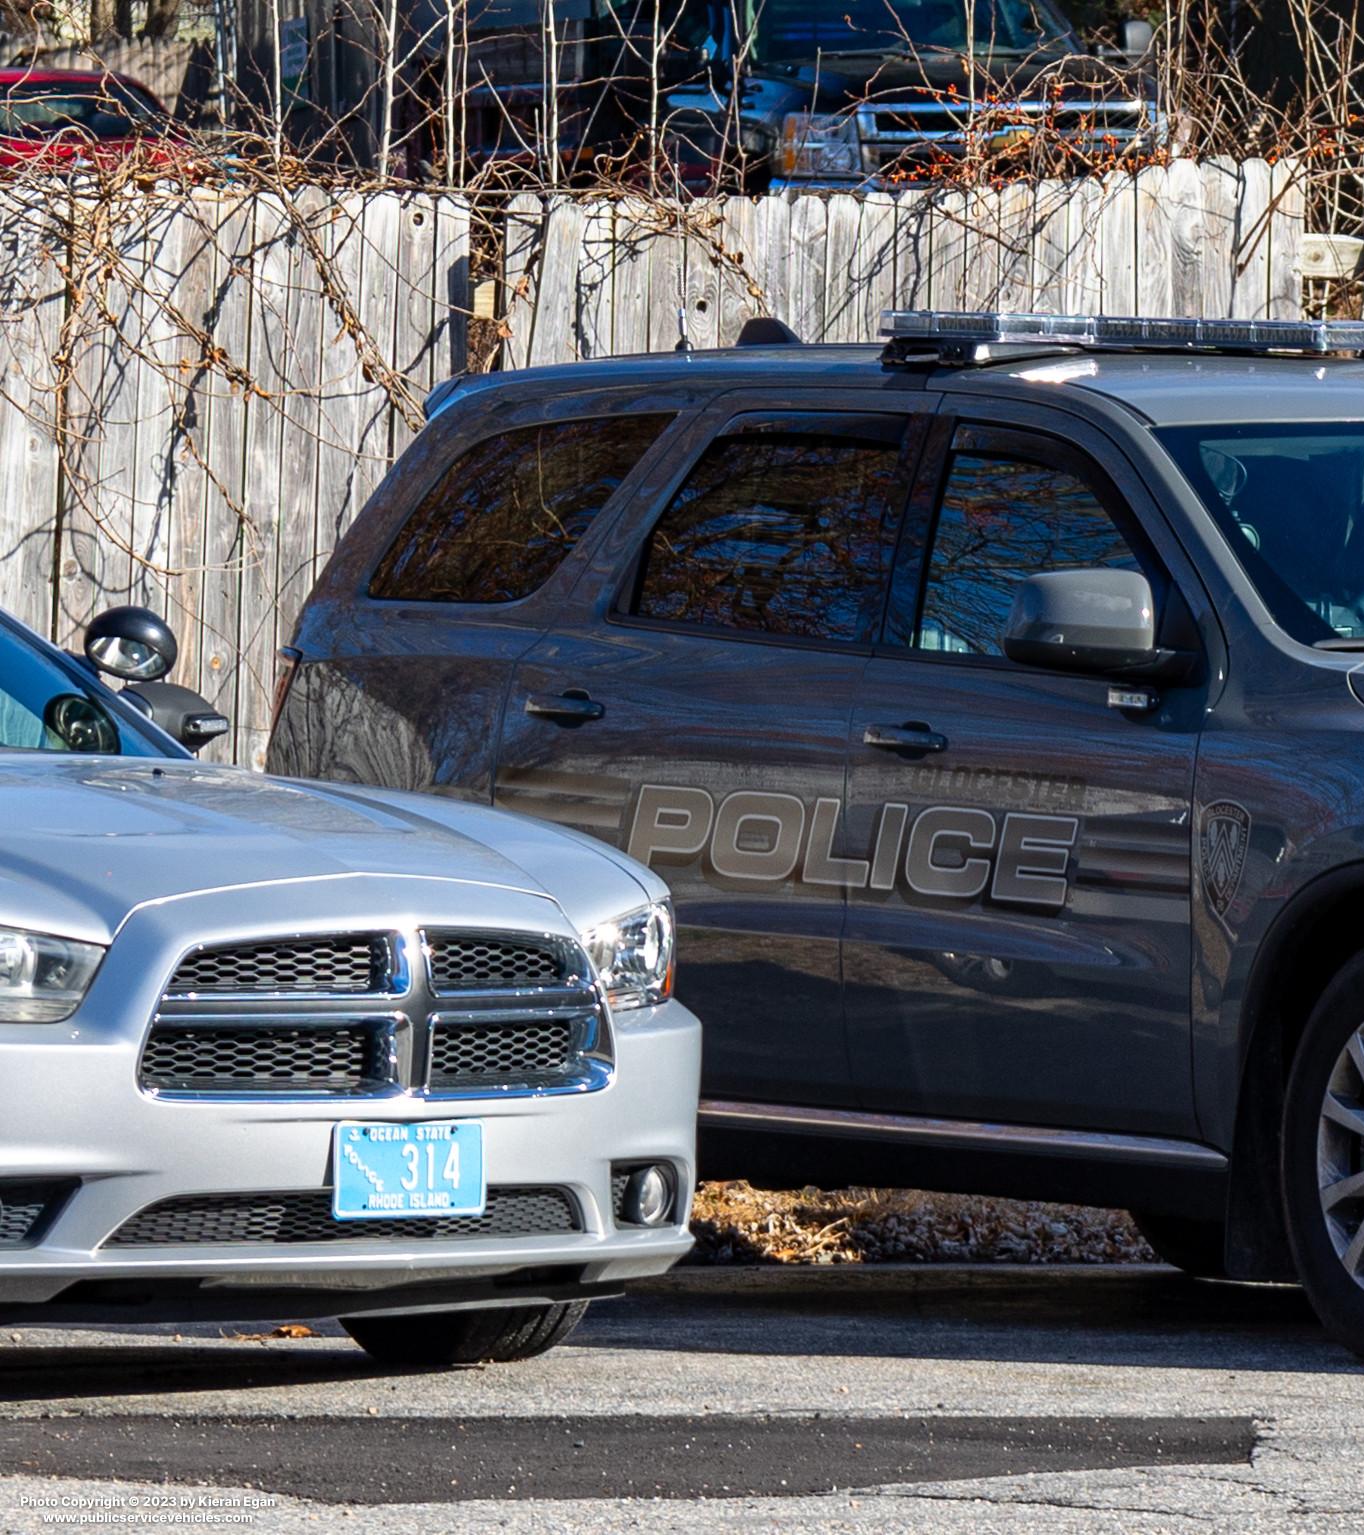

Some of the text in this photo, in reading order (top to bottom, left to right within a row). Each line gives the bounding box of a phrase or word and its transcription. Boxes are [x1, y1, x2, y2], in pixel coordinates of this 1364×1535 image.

[627, 784, 1079, 905] POLICE
[369, 1126, 450, 1142] OCEAN STATE
[343, 1144, 384, 1192] POLICE
[401, 1142, 461, 1191] 314
[368, 1192, 449, 1209] RHODE ISLAND
